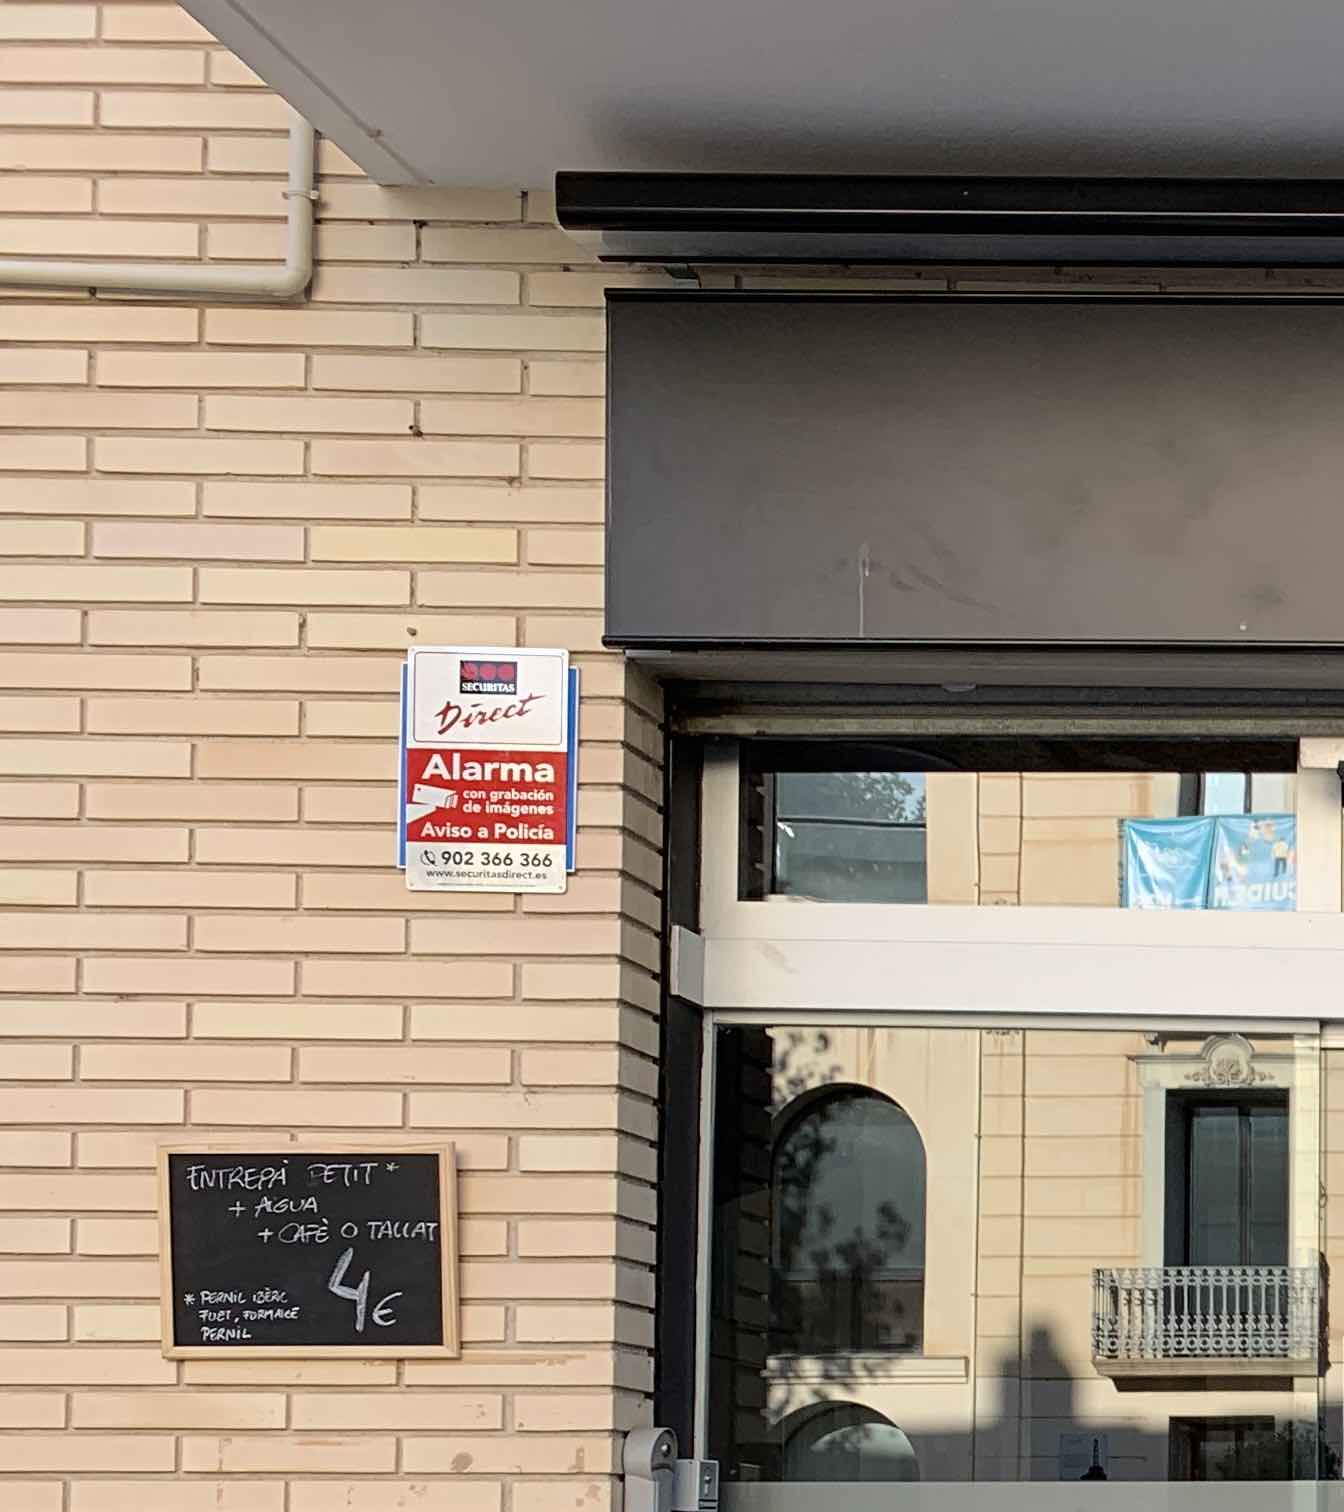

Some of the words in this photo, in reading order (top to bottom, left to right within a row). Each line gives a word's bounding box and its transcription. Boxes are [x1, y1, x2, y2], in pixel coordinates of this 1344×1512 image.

[461, 682, 516, 694] SECURITAS
[434, 692, 546, 736] Direct
[422, 753, 556, 784] Alarma
[463, 790, 487, 801] con
[489, 789, 554, 803] grabación
[463, 802, 482, 814] de
[485, 802, 554, 816] imágenes
[421, 823, 472, 838] Aviso
[477, 828, 489, 838] a
[494, 823, 554, 841] Policía
[441, 851, 478, 867] 902
[481, 852, 513, 868] 366
[520, 853, 553, 868] 366
[425, 869, 548, 881] www.securitasdirect.es
[200, 1325, 253, 1342] PERNIL
